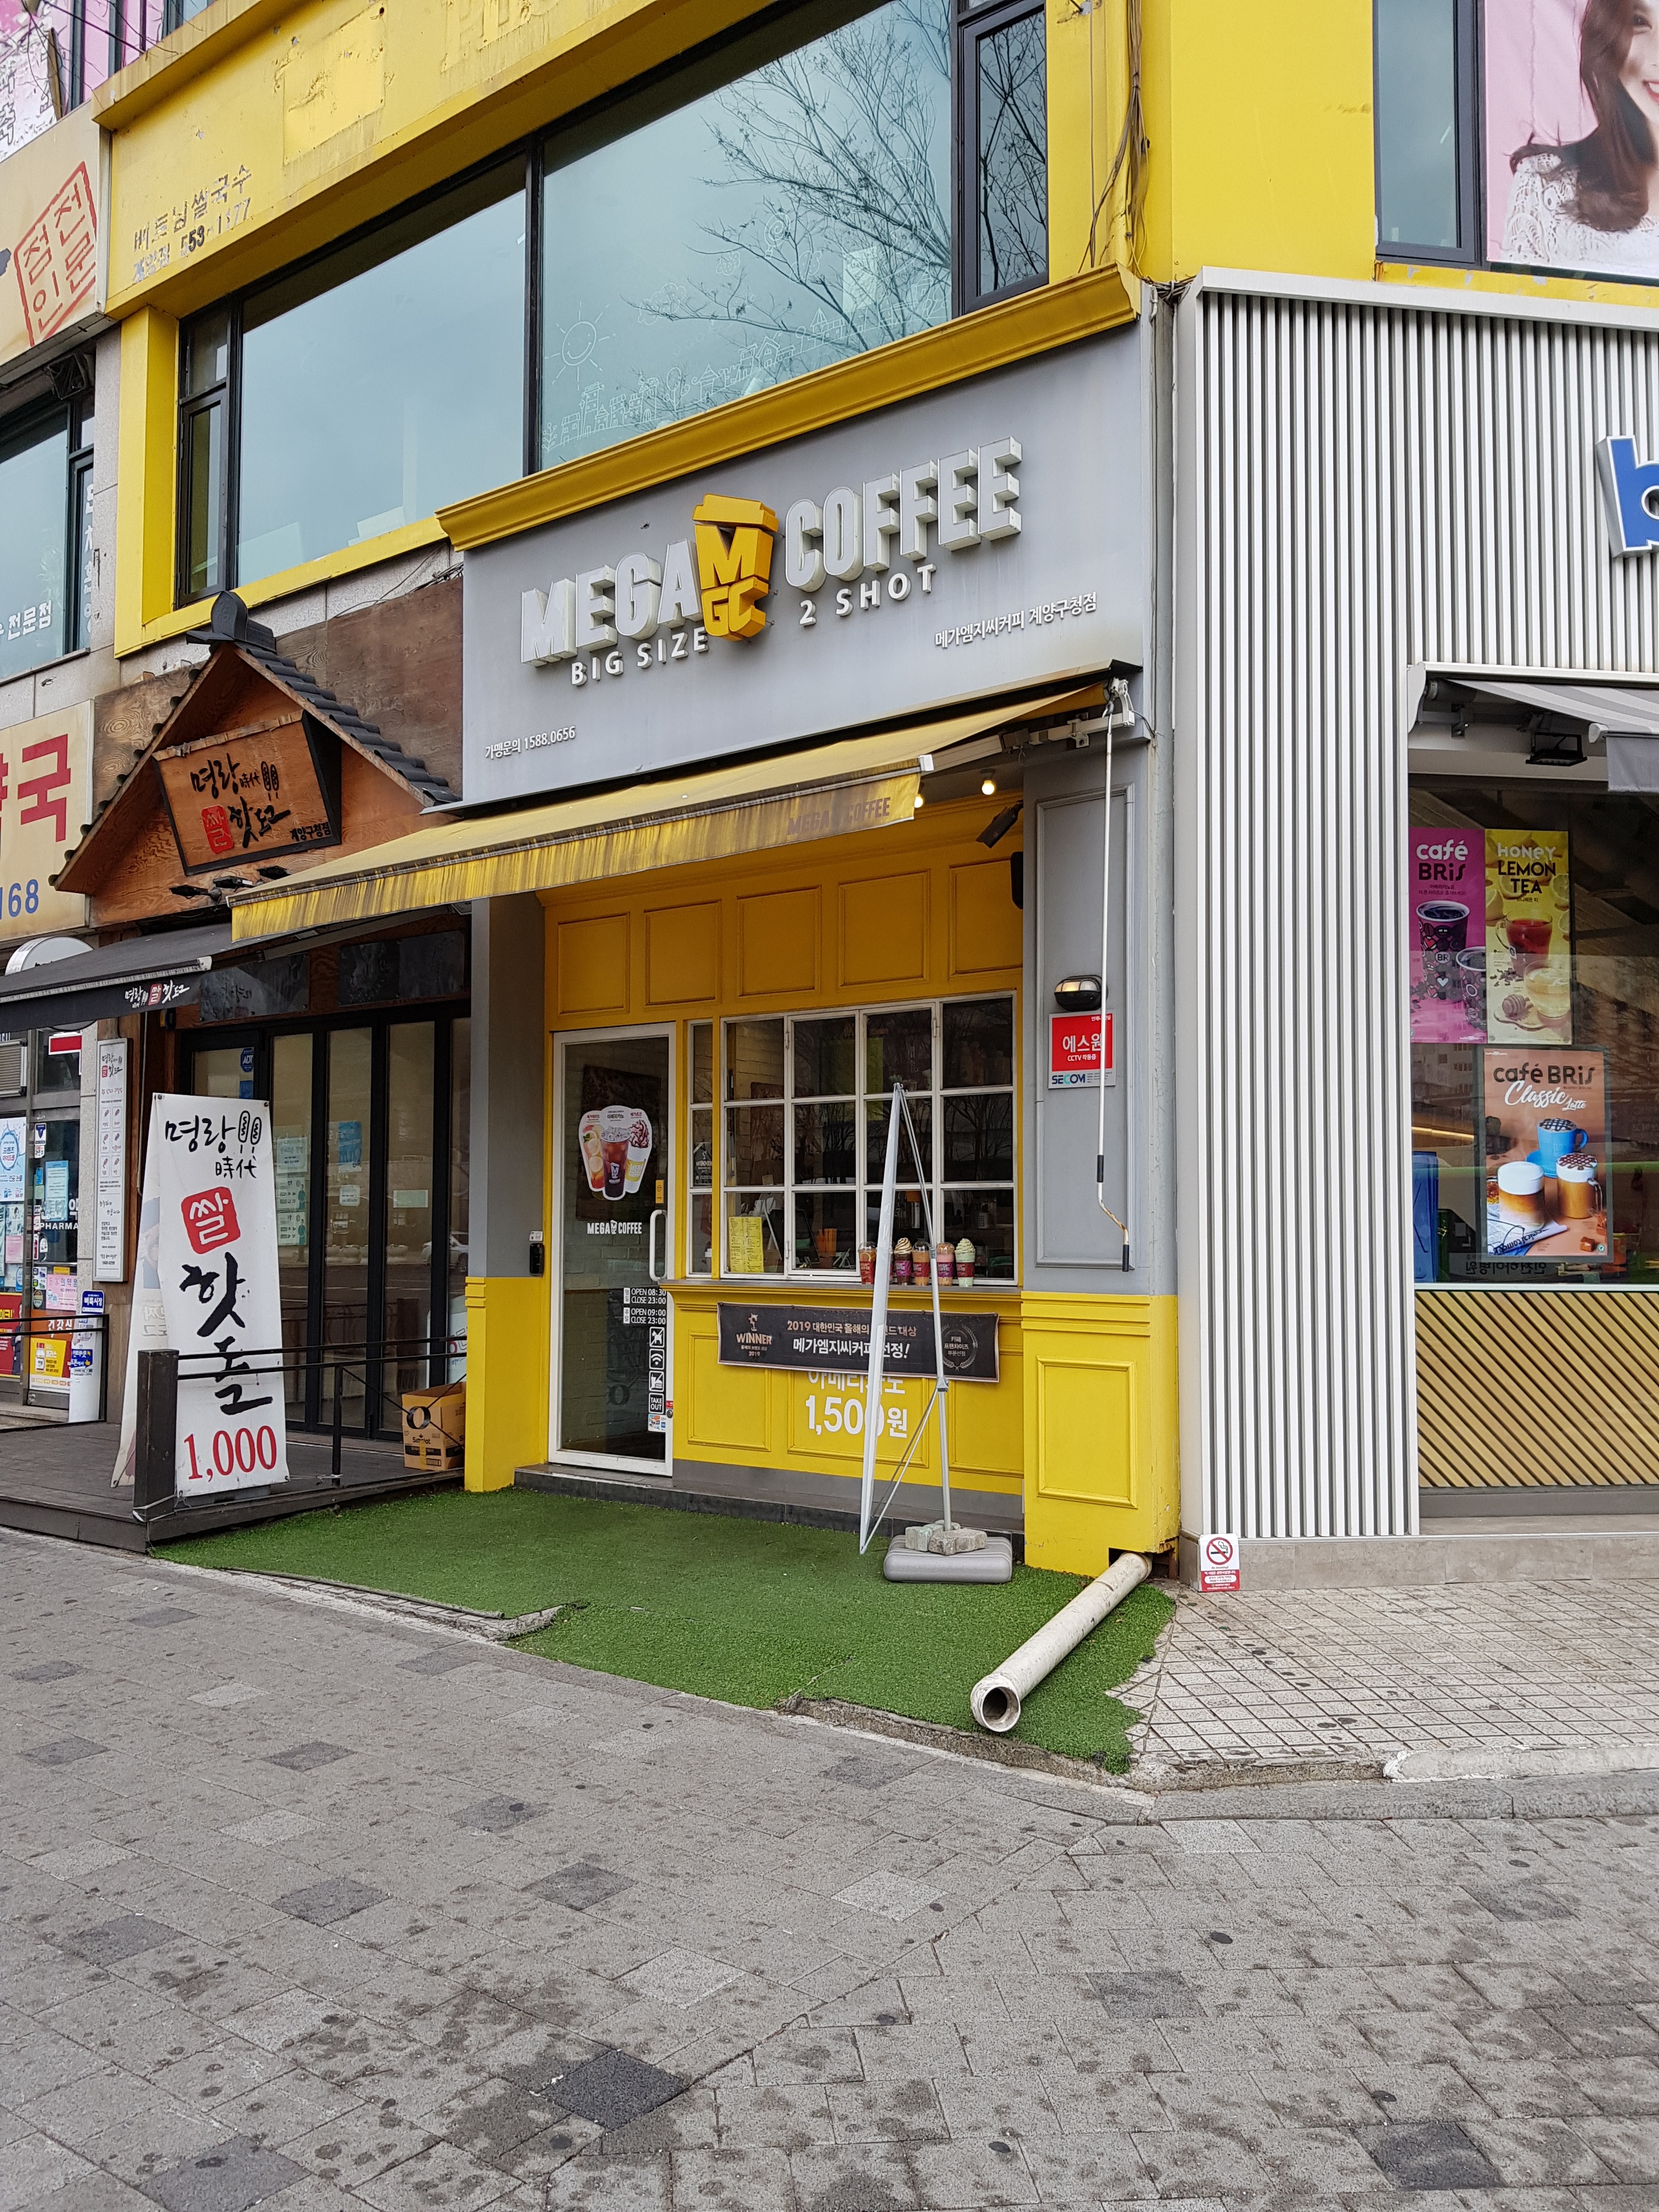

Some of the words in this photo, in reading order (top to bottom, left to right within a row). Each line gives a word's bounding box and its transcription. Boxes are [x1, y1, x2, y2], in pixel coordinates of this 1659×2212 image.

[521, 538, 703, 668] MEGA
[785, 436, 1022, 592] COFFEE
[571, 651, 623, 686] BIG
[637, 627, 709, 668] SIZE
[800, 600, 816, 626] 2
[836, 564, 936, 617] SHOT
[935, 610, 1024, 648] 메가엠지씨커피
[1029, 591, 1096, 624] 계양구청점
[485, 738, 521, 759] 가맹문의
[524, 726, 575, 749] 1588.0656
[190, 753, 240, 799] 명랑
[0, 733, 71, 856] 국
[228, 796, 291, 848] 핫도그
[787, 810, 829, 835] MEGA
[844, 797, 890, 823] COFFEE
[290, 822, 331, 841] 계양구청점
[1417, 839, 1468, 861] café
[1498, 860, 1556, 877] LEMON
[1510, 878, 1542, 894] TEA
[1063, 1034, 1102, 1052] 에스원
[242, 1054, 253, 1064] ADT
[1052, 1074, 1085, 1085] SECOM
[1493, 1062, 1543, 1084] café
[1505, 1080, 1568, 1108] Classic
[1562, 1098, 1586, 1111] Latte
[165, 1115, 236, 1153] 명랑
[216, 1156, 257, 1179] 時代
[189, 1193, 229, 1245] 쌀
[587, 1222, 611, 1234] MEGA
[618, 1222, 642, 1234] COFFEE
[179, 1252, 273, 1415] 핫도그
[736, 1333, 772, 1345] WINNER
[787, 1321, 811, 1331] 2019
[812, 1322, 843, 1333] 대한민국
[844, 1323, 869, 1335] 올해의
[898, 1326, 917, 1337] 대상
[808, 1372, 905, 1394] 아메리노
[184, 1426, 277, 1482] 1,000
